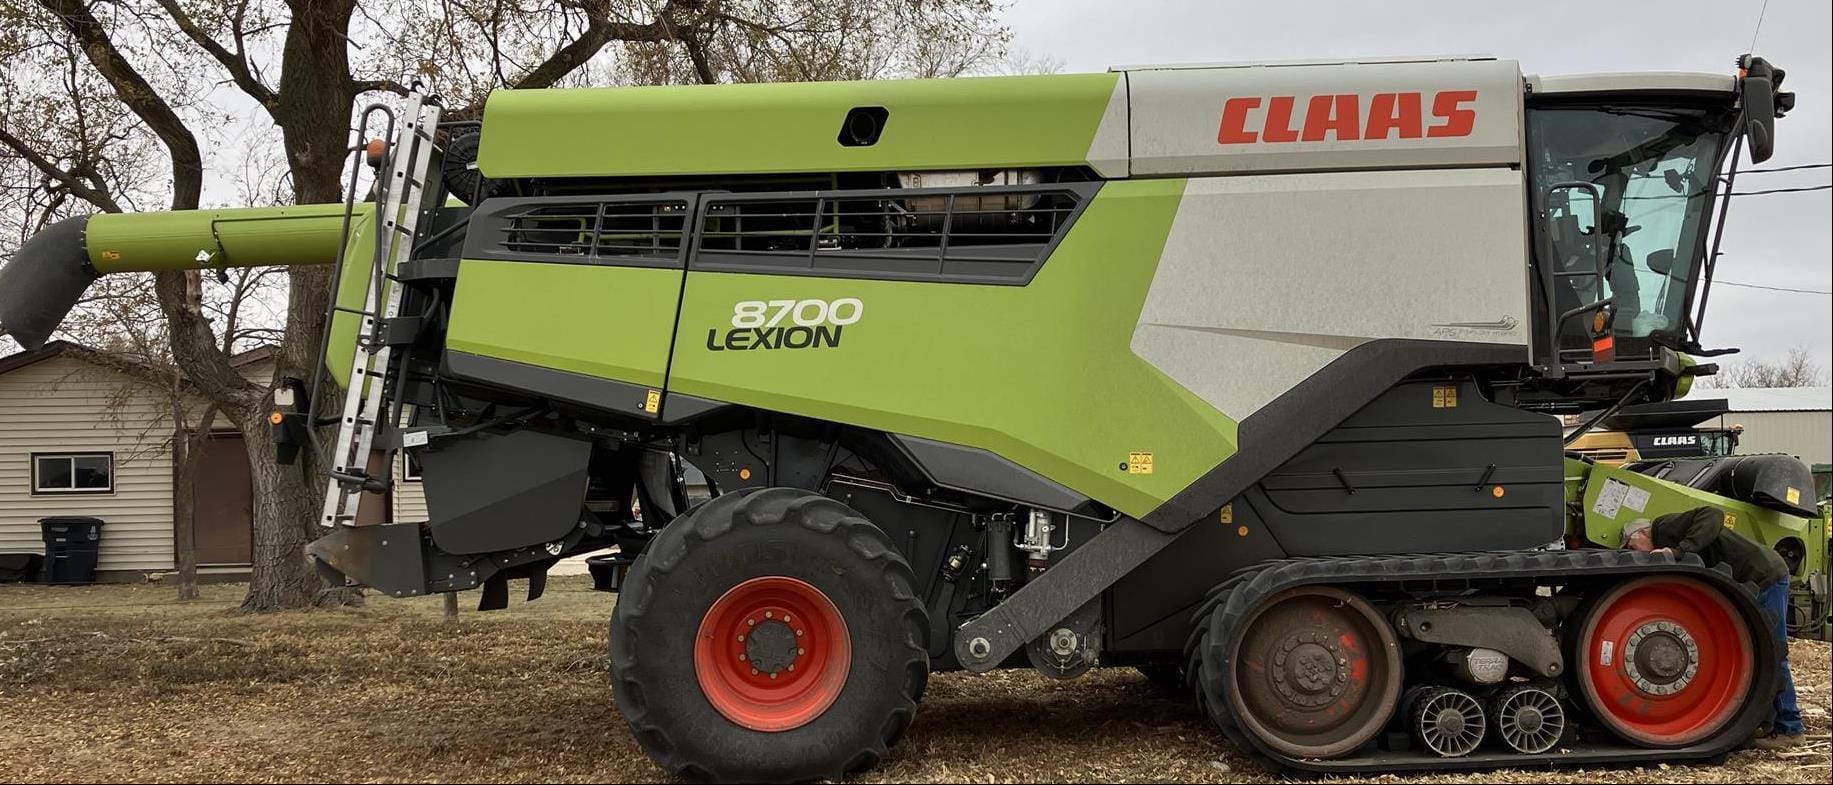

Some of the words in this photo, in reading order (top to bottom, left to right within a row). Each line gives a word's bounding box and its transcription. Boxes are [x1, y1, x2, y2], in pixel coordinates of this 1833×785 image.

[1217, 90, 1478, 145] CLAAS
[732, 297, 864, 328] 8700
[706, 325, 843, 351] LEXION
[1653, 435, 1697, 446] CLAAS
